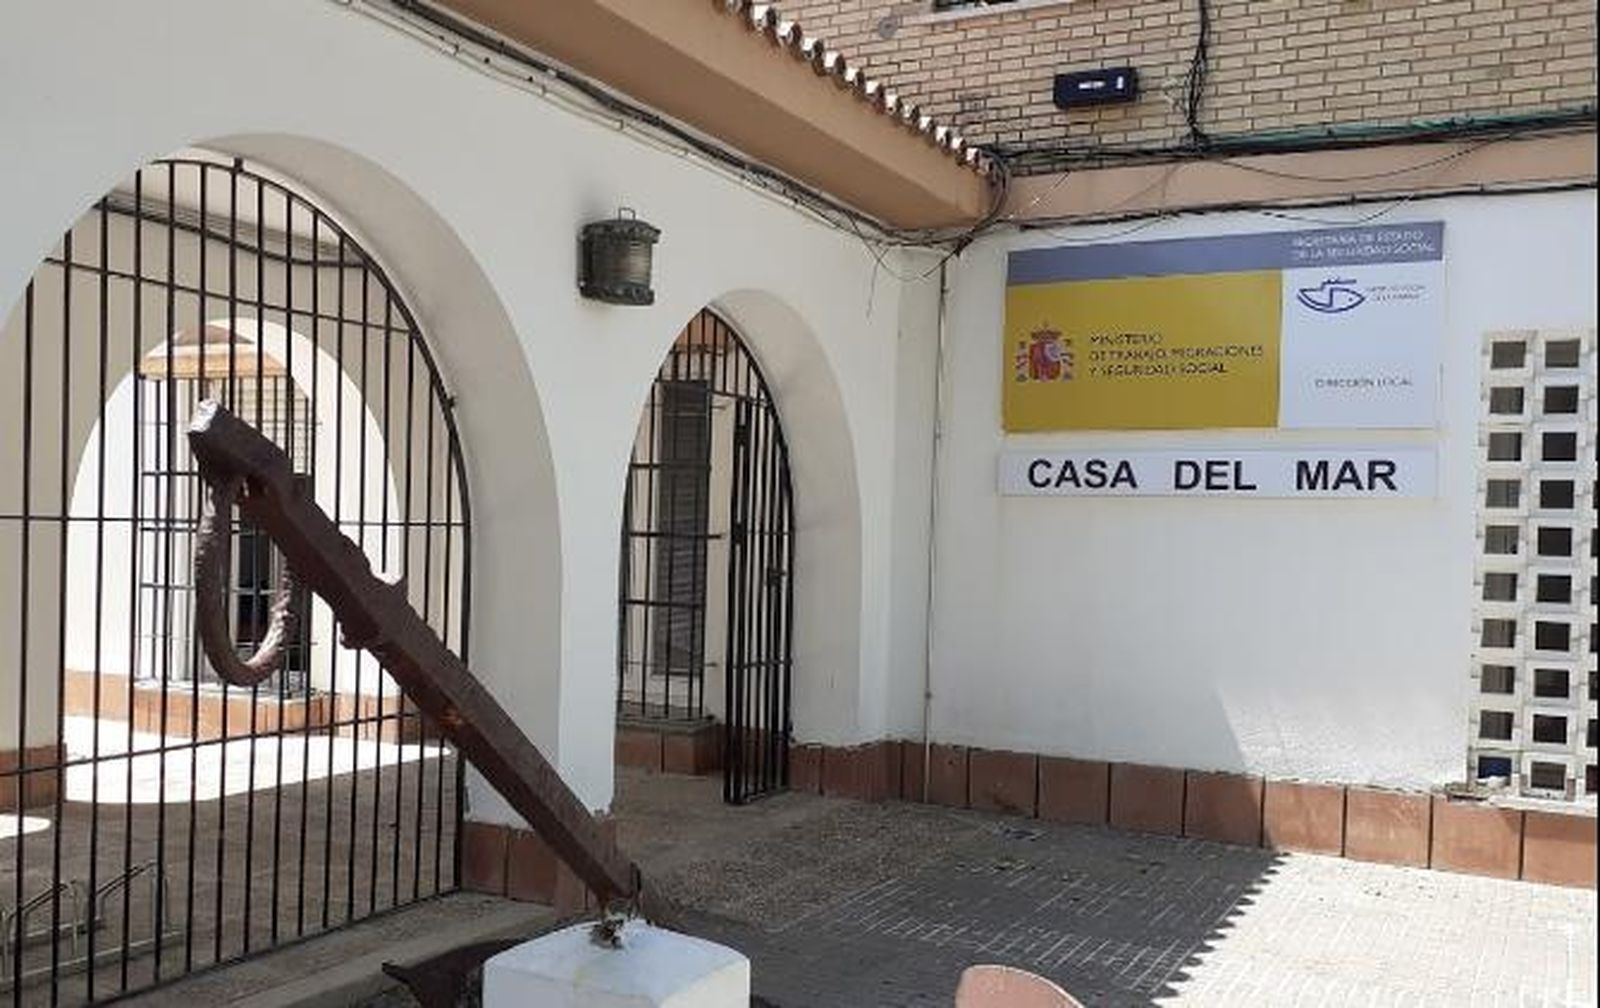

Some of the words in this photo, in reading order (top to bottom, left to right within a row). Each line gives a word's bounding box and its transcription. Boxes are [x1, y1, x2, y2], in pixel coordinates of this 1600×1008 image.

[1027, 459, 1138, 489] CASA
[1173, 460, 1257, 491] DEL
[1295, 460, 1398, 491] MAR
